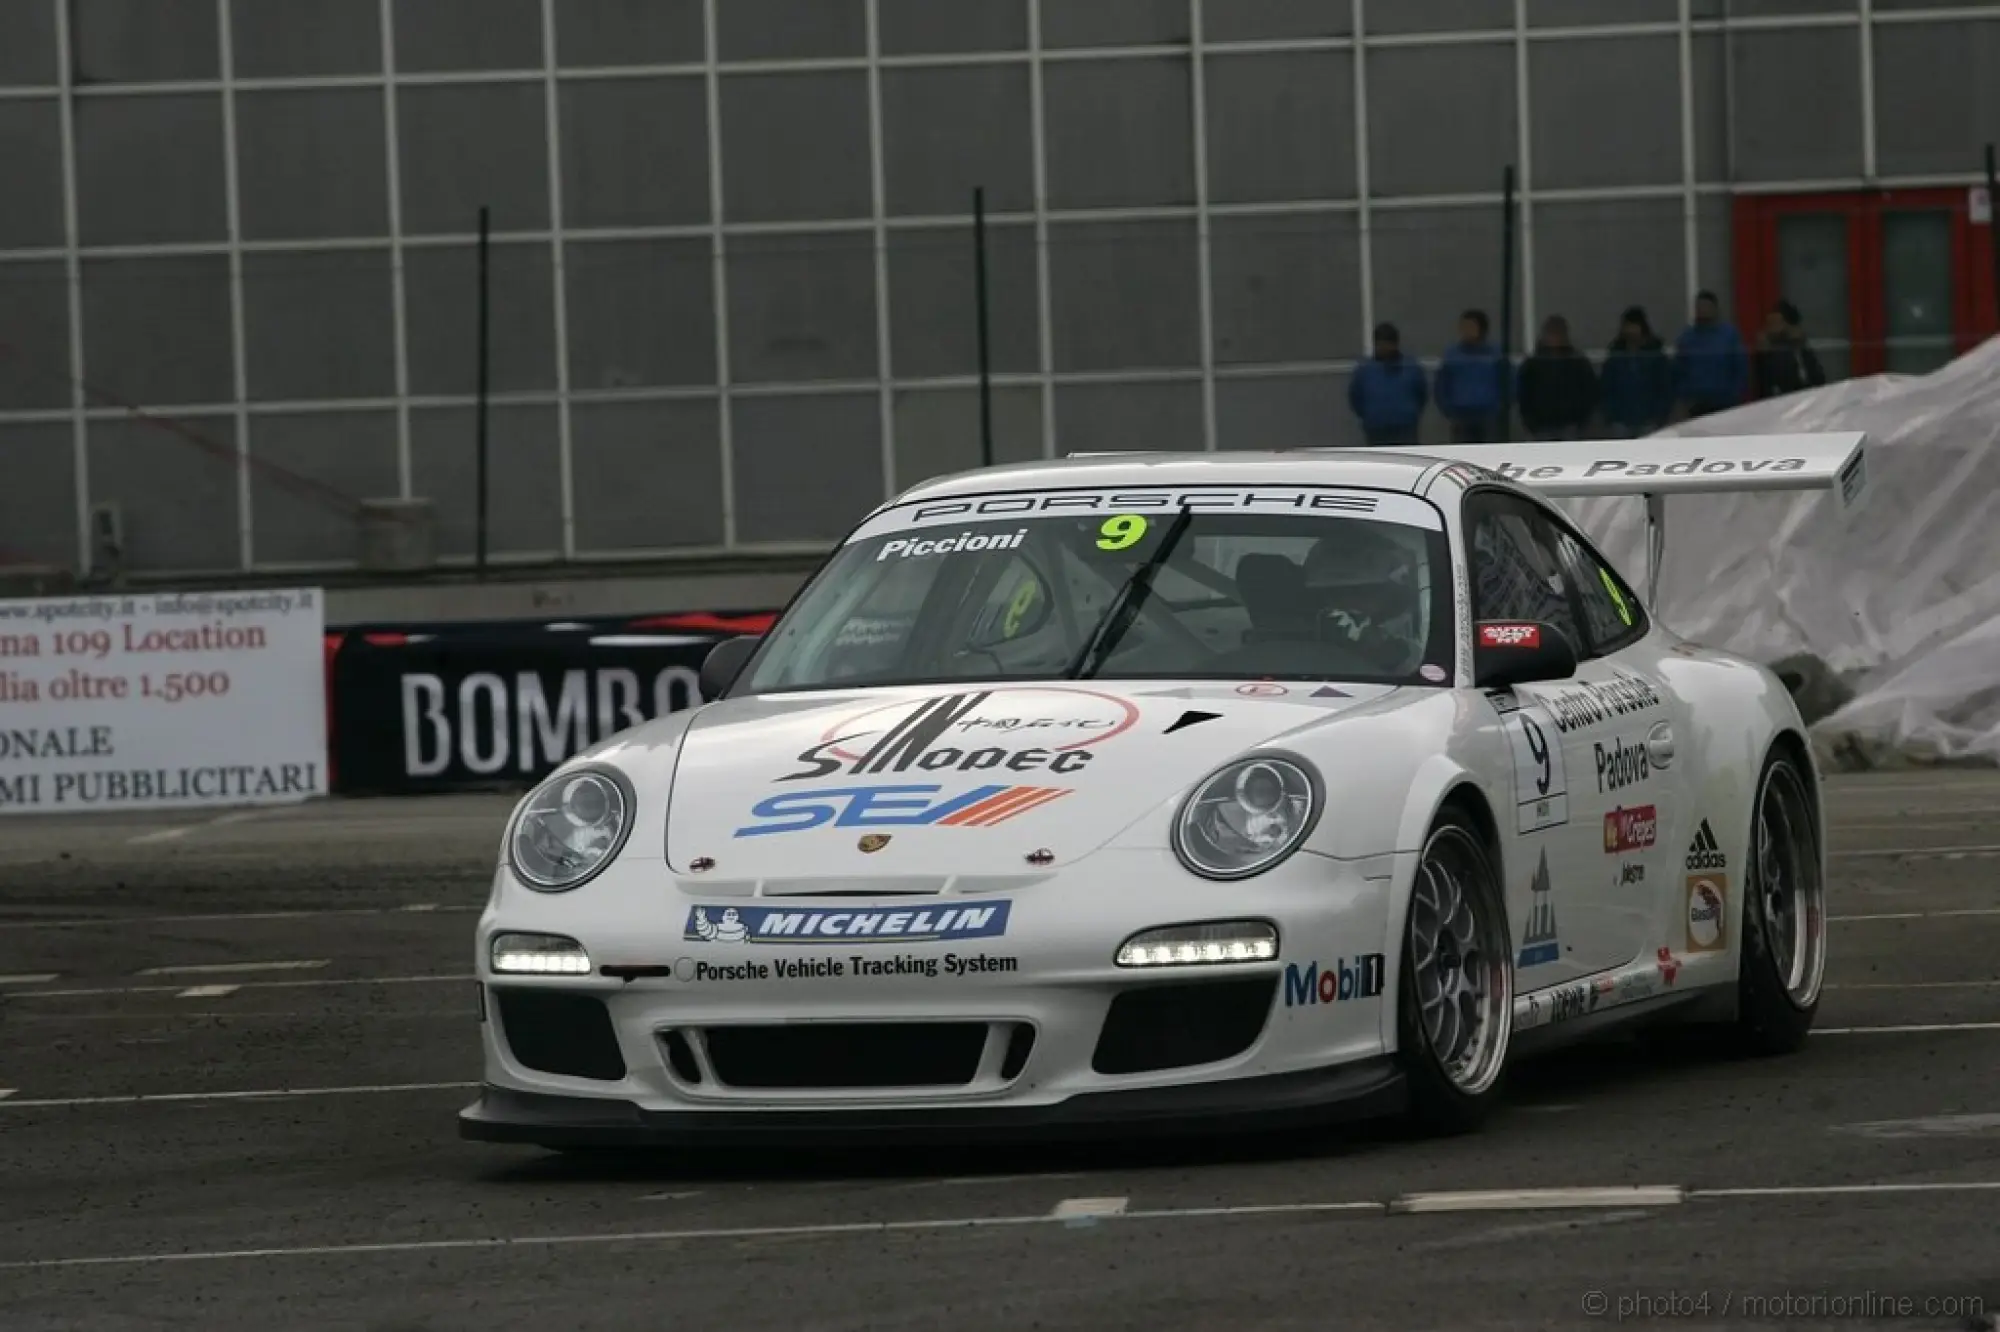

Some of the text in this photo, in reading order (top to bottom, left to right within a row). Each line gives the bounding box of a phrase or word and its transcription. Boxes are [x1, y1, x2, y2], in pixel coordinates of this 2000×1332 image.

[1583, 457, 1806, 478] Padova
[913, 493, 1378, 522] PORSCHE
[877, 529, 1027, 562] Piccioni
[1096, 514, 1148, 550] 9
[53, 629, 111, 660] 109
[123, 620, 266, 652] Location
[49, 669, 127, 699] oltre
[140, 671, 230, 702] 1.500
[1519, 712, 1549, 795] 9
[1594, 736, 1649, 794] Padova
[55, 763, 316, 801] PUBBLICITARI
[1686, 851, 1727, 869] adidas
[758, 906, 997, 936] MICHELIN
[696, 954, 1018, 981] Porsche Vehicle Tracking System
